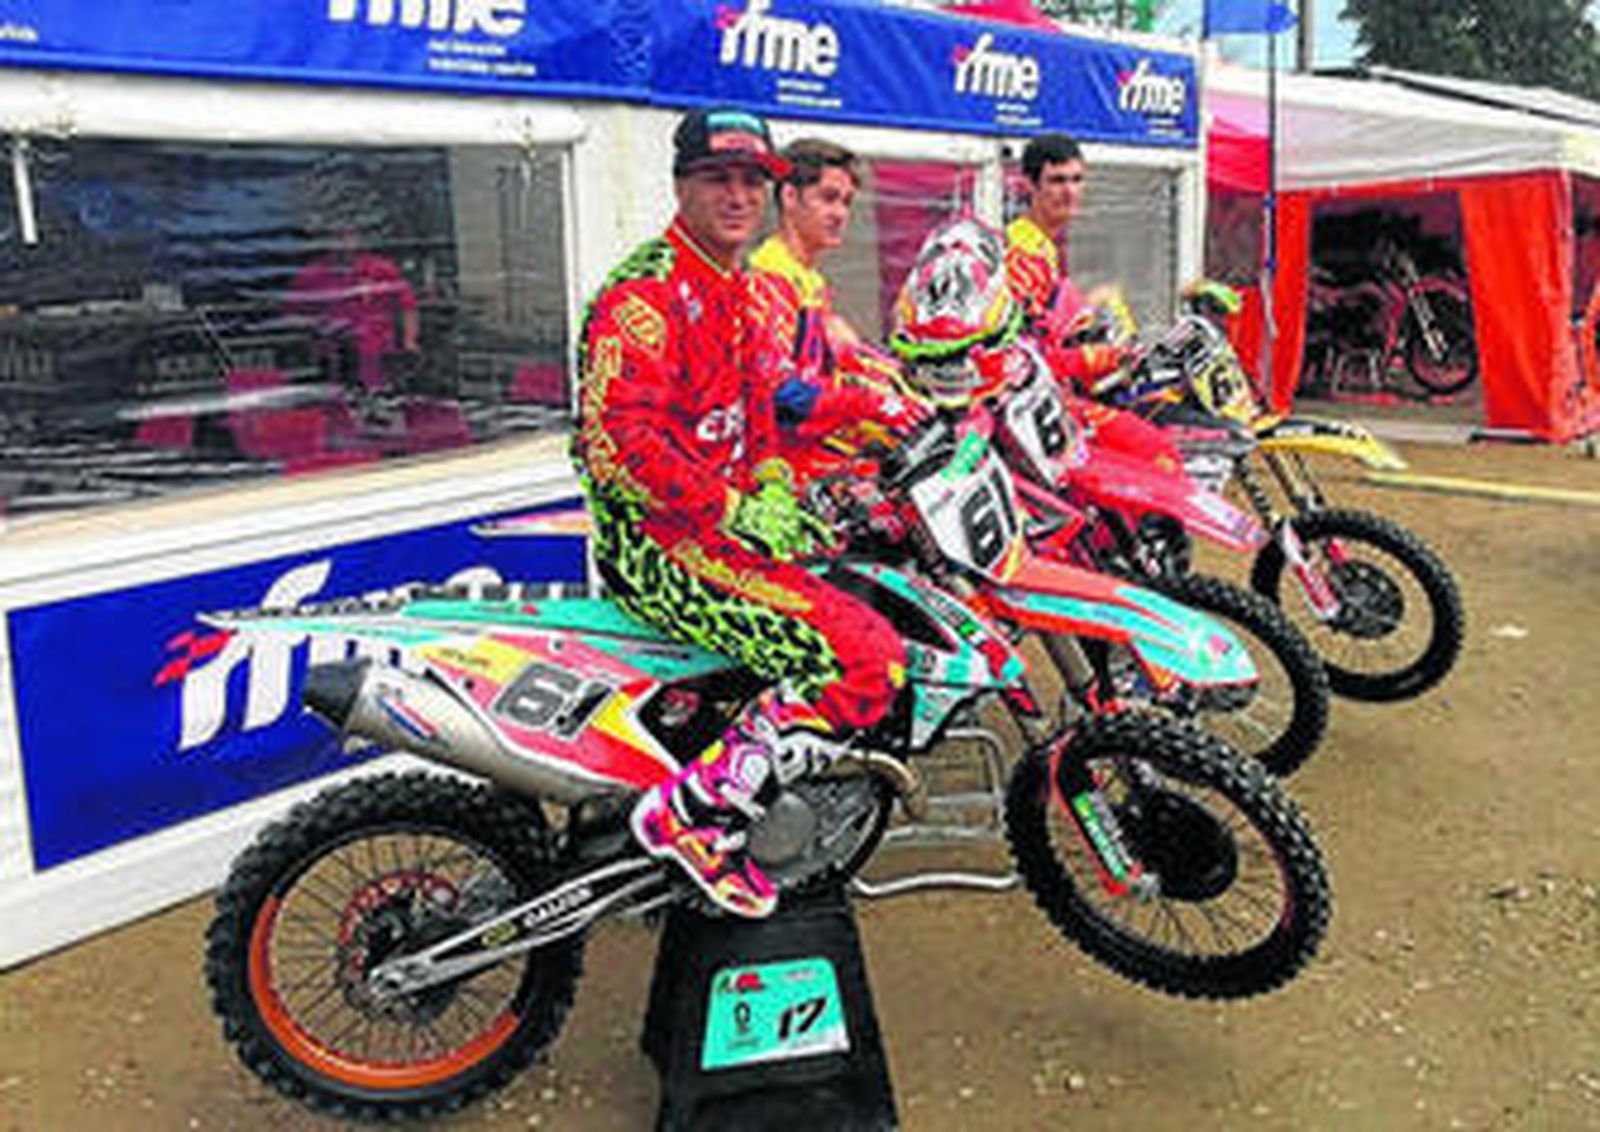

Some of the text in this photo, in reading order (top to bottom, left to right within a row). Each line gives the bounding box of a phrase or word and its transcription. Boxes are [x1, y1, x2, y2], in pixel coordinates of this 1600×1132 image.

[720, 0, 839, 76] rfme
[954, 33, 1039, 99] rfme
[779, 998, 826, 1041] 17
